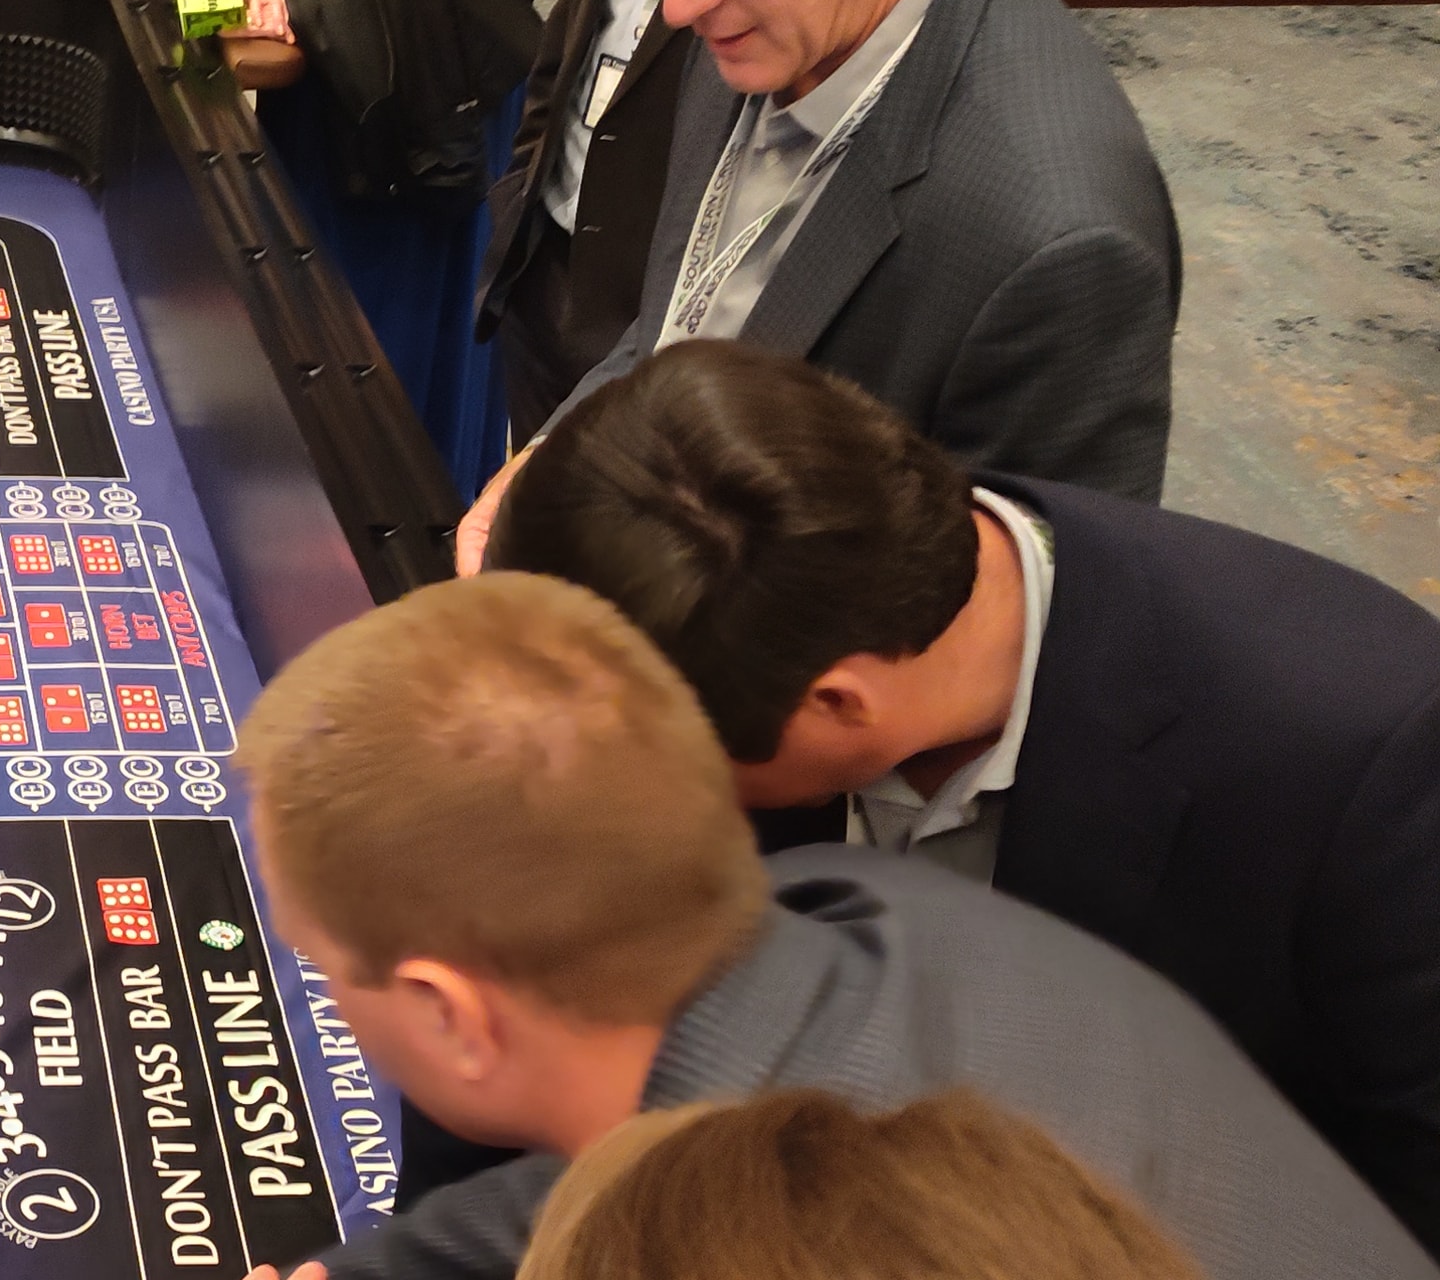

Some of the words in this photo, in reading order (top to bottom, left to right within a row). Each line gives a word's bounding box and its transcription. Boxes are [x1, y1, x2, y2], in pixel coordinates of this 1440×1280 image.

[683, 195, 718, 291] SOUTHERN
[33, 309, 79, 351] LINE
[99, 324, 138, 370] PARTY
[45, 352, 93, 400] PASS
[115, 371, 156, 426] CASINO
[0, 393, 38, 445] DON'T
[100, 604, 133, 650] HORN
[131, 612, 160, 641] BET
[160, 590, 197, 636] CRAPS
[176, 635, 207, 668] ANY
[121, 964, 171, 1029] BAR
[202, 969, 279, 1067] LINE
[30, 989, 83, 1086] FIELD
[306, 989, 375, 1101] PARTY
[135, 1043, 192, 1128] PASS
[228, 1075, 312, 1196] PASS
[341, 1108, 399, 1228] ASINO
[20, 1186, 78, 1220] 2
[152, 1135, 220, 1265] DON'T
